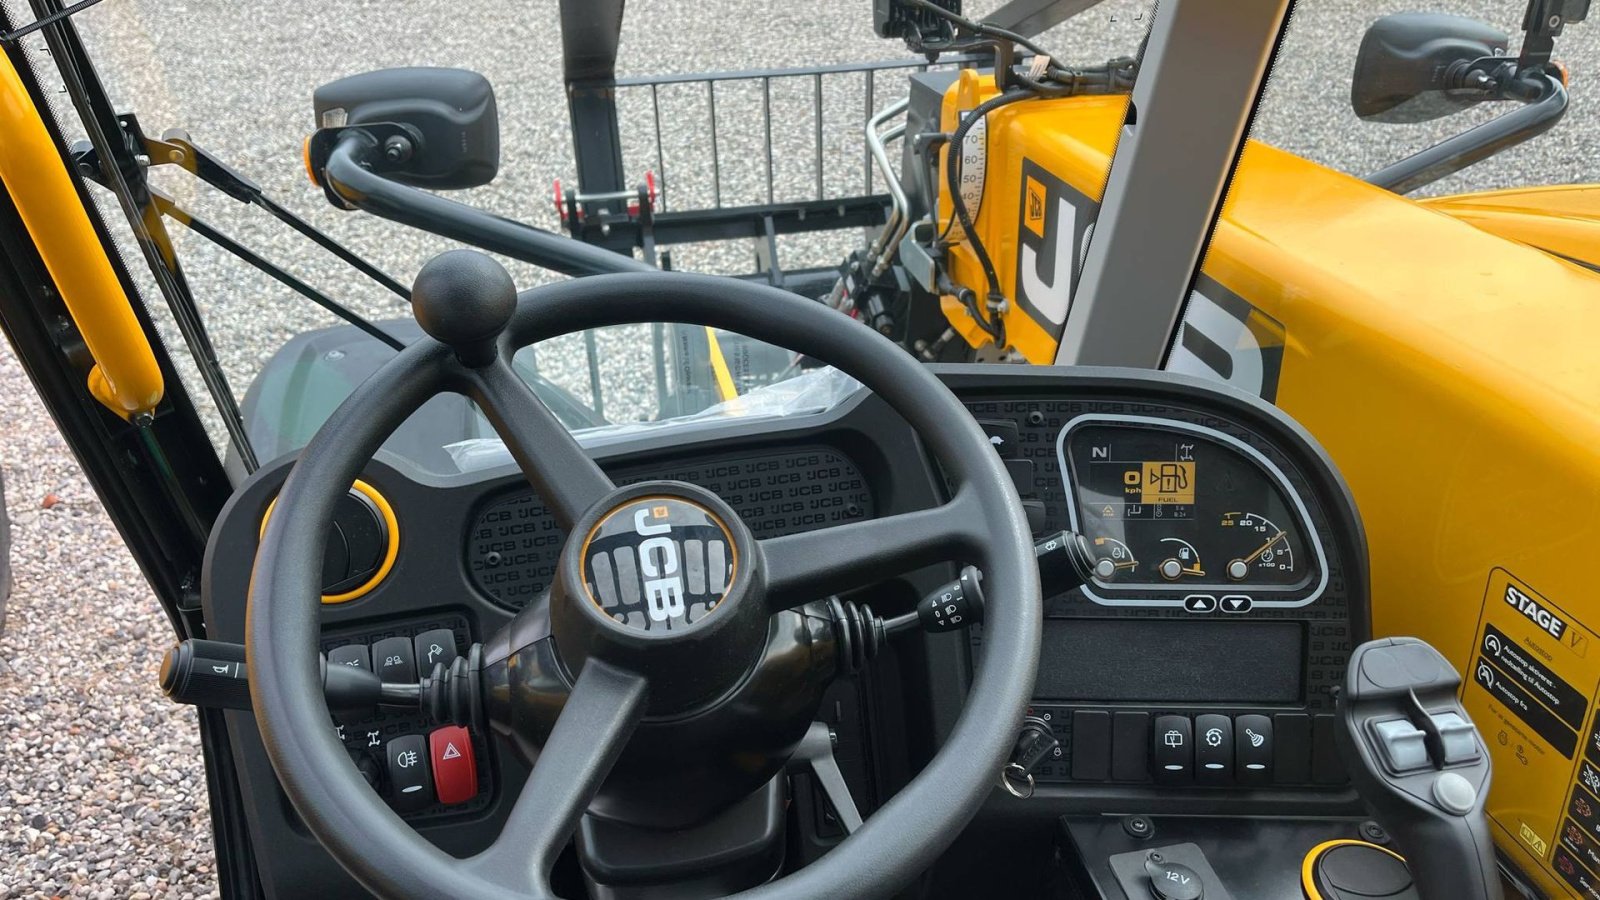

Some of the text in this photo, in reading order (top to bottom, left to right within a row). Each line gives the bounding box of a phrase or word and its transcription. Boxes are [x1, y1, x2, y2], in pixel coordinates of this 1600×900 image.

[965, 134, 978, 144] 70
[964, 155, 978, 164] 60
[963, 174, 976, 183] 50
[1092, 446, 1108, 458] N
[705, 466, 740, 479] JCB
[746, 461, 780, 474] JCB
[785, 455, 820, 468] JCB
[727, 478, 761, 491] JCB
[767, 473, 801, 486] JCB
[807, 467, 841, 480] JCB
[1124, 470, 1141, 485] 0
[750, 489, 783, 502] JCB
[789, 484, 823, 497] JCB
[828, 479, 863, 492] JCB
[1125, 486, 1142, 494] kph
[771, 501, 804, 514] JCB
[810, 496, 844, 509] JCB
[498, 523, 536, 536] JCB
[753, 519, 786, 532] JCB
[792, 513, 826, 526] JCB
[480, 535, 560, 554] JCB JCB
[503, 553, 539, 566] JCB
[634, 508, 685, 622] JCB
[483, 570, 520, 584] JCB
[1505, 586, 1584, 648] STAGE V
[1503, 645, 1528, 667] Autostop
[1495, 681, 1520, 704] Autostop
[1534, 681, 1560, 705] Autostop
